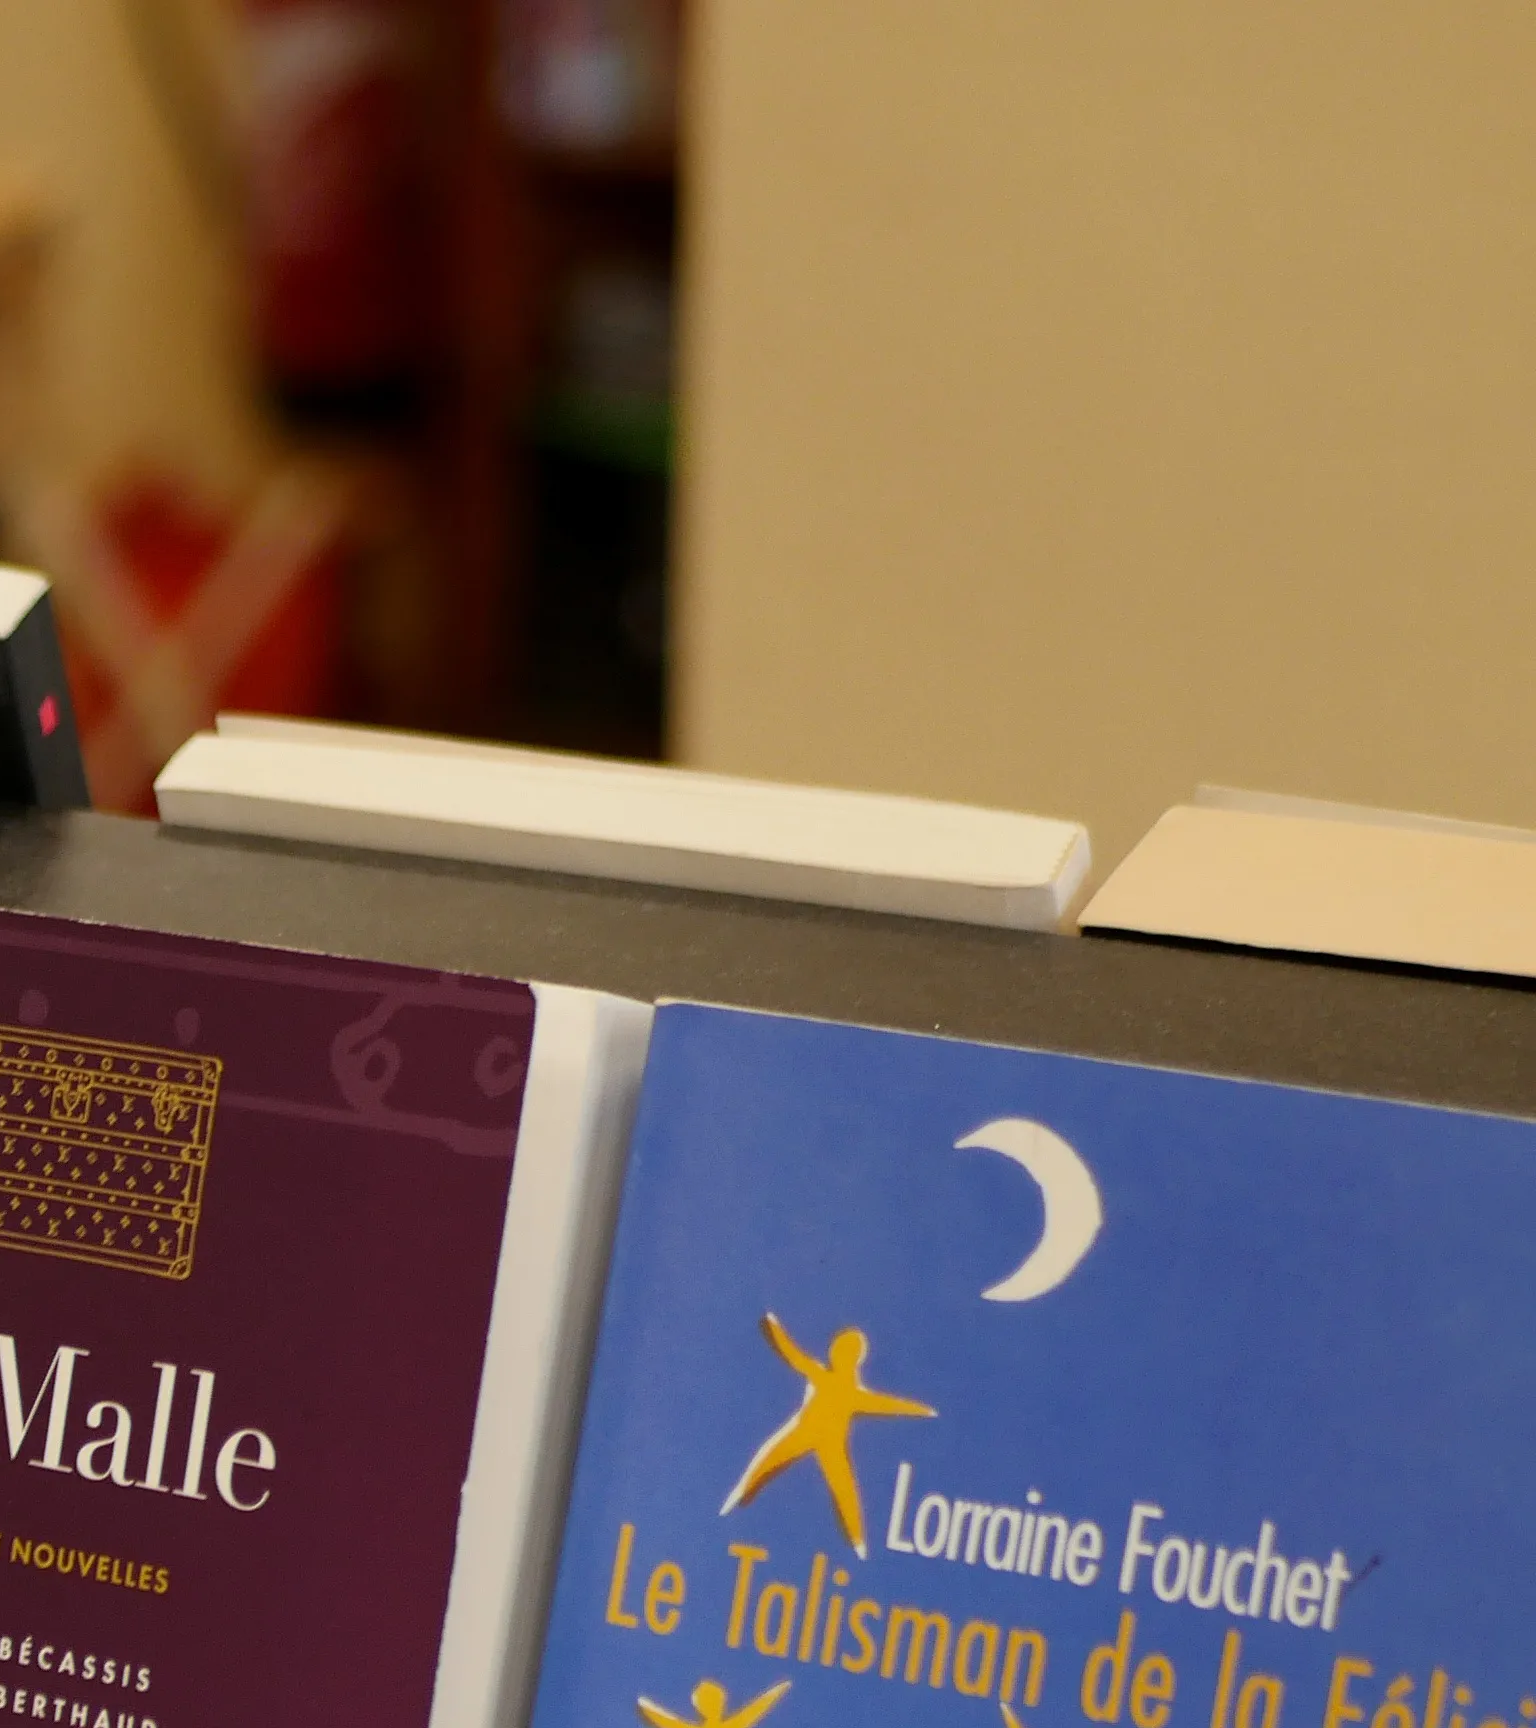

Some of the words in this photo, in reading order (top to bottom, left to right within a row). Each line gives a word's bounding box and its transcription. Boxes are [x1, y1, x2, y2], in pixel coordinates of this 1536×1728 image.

[10, 1536, 171, 1596] NOUVELLES
[603, 1521, 689, 1637] Le
[724, 1541, 1049, 1709] Talisman
[885, 1461, 1104, 1590] Lorraine
[1119, 1502, 1353, 1632] Fouchet
